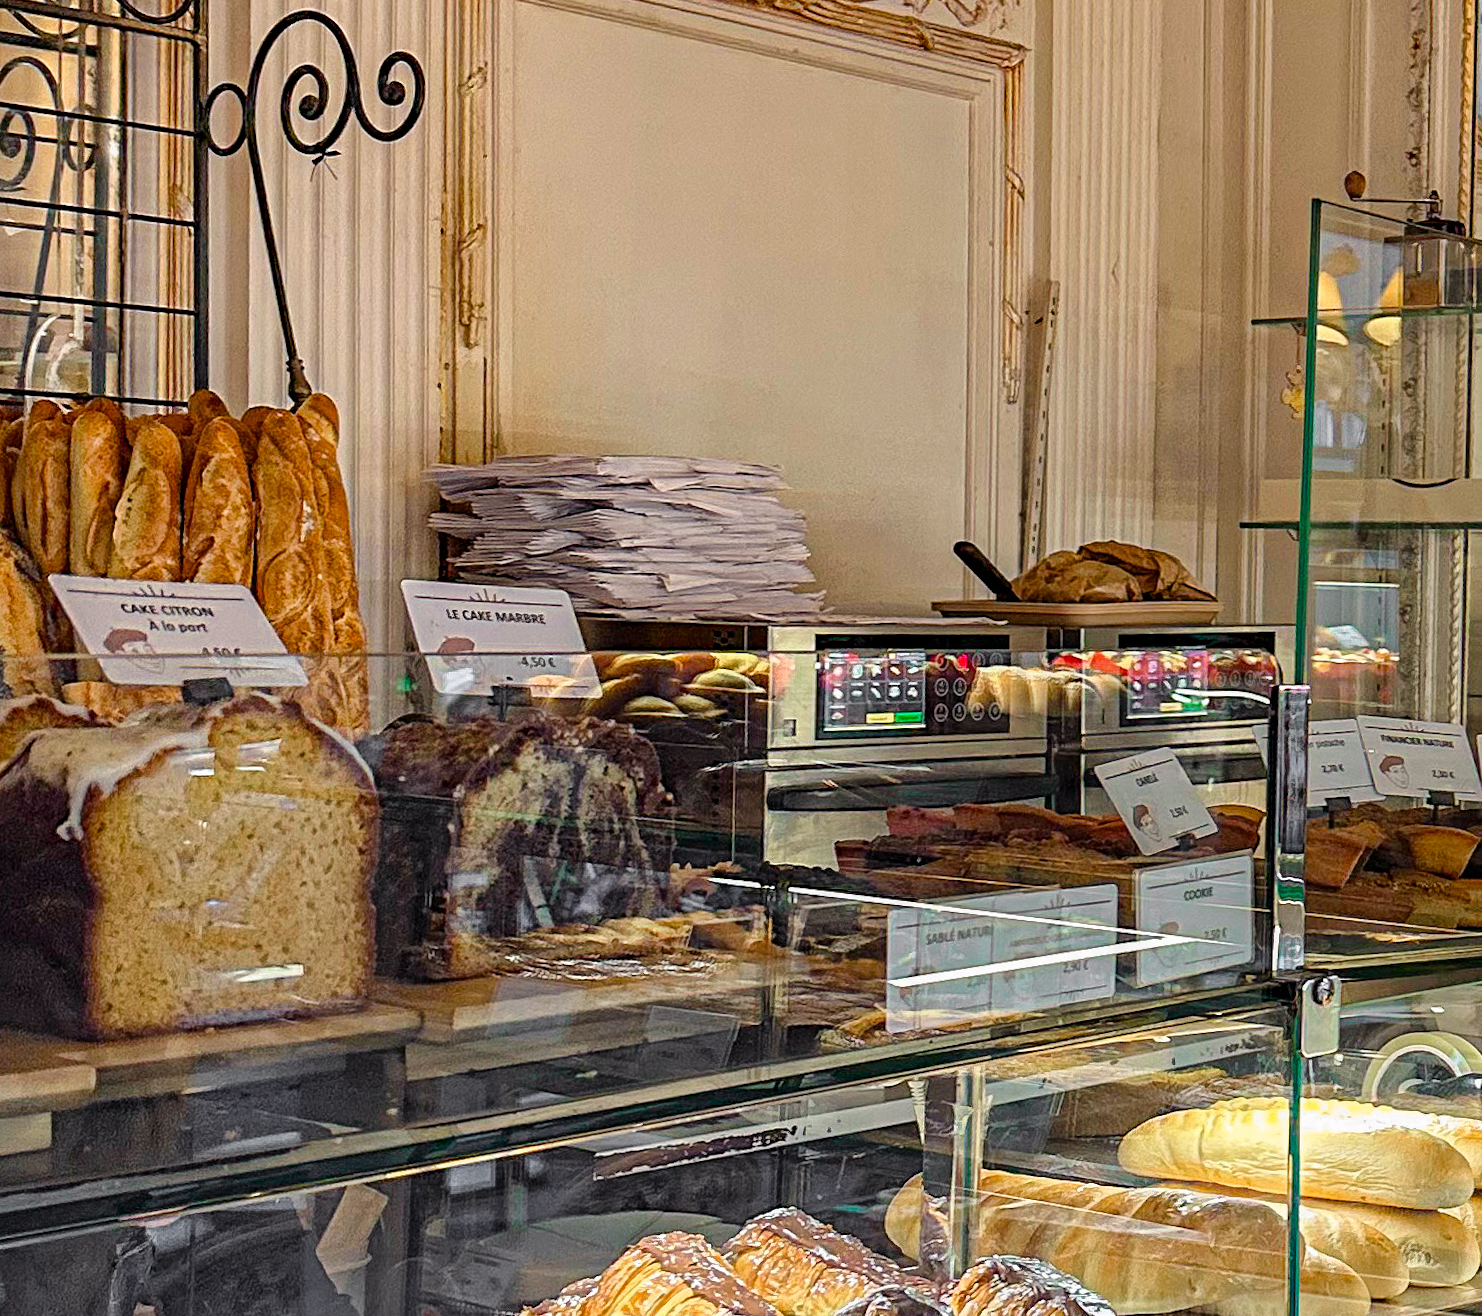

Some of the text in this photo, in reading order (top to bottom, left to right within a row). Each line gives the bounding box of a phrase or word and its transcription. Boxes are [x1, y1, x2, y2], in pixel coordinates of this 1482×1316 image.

[121, 604, 214, 617] CAKE CITRON
[446, 609, 460, 620] LE
[462, 610, 493, 621] CAKE
[163, 620, 176, 631] la
[549, 658, 556, 668] €
[1184, 887, 1213, 901] COOKIE
